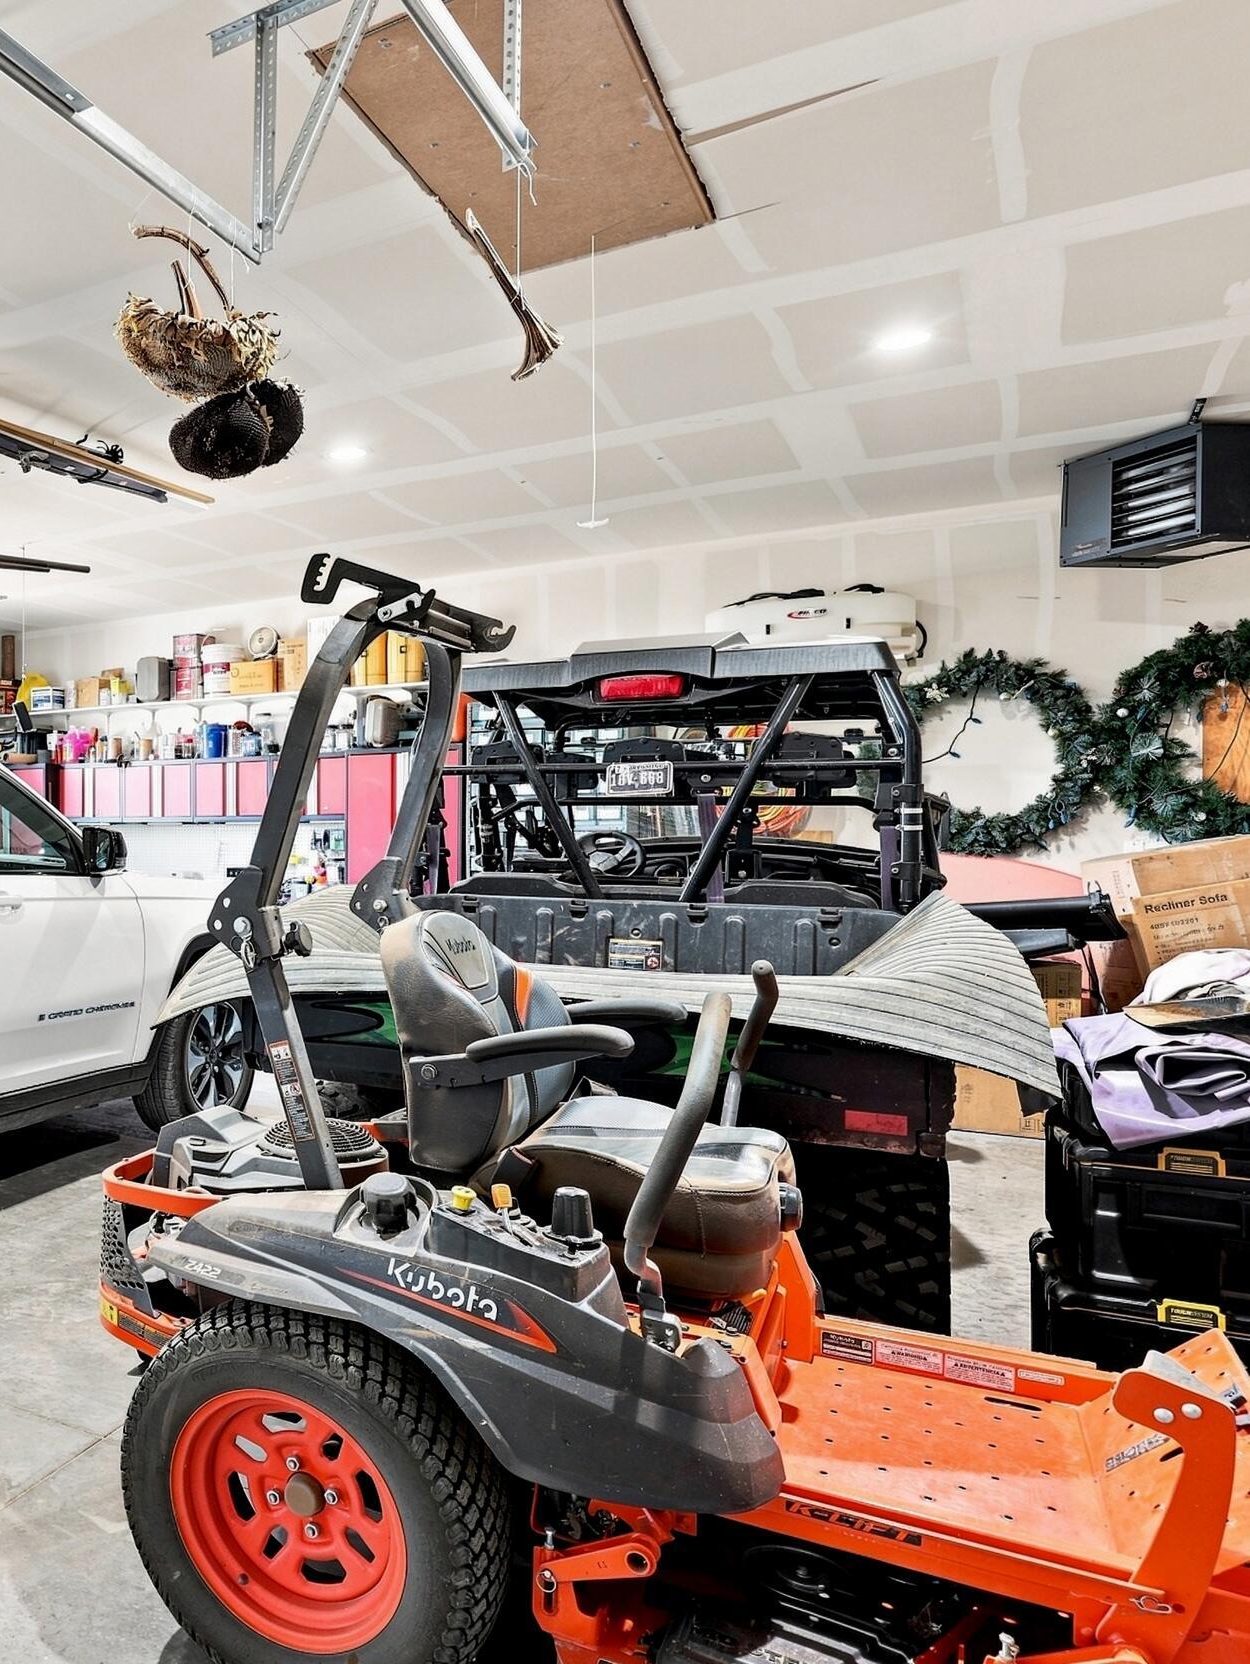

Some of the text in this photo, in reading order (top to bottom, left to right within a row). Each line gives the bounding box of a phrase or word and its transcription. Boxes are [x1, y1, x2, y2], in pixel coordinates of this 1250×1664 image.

[1144, 893, 1228, 914] Recliner Sofa
[185, 1259, 222, 1279] Z422
[387, 1257, 499, 1321] Kubota
